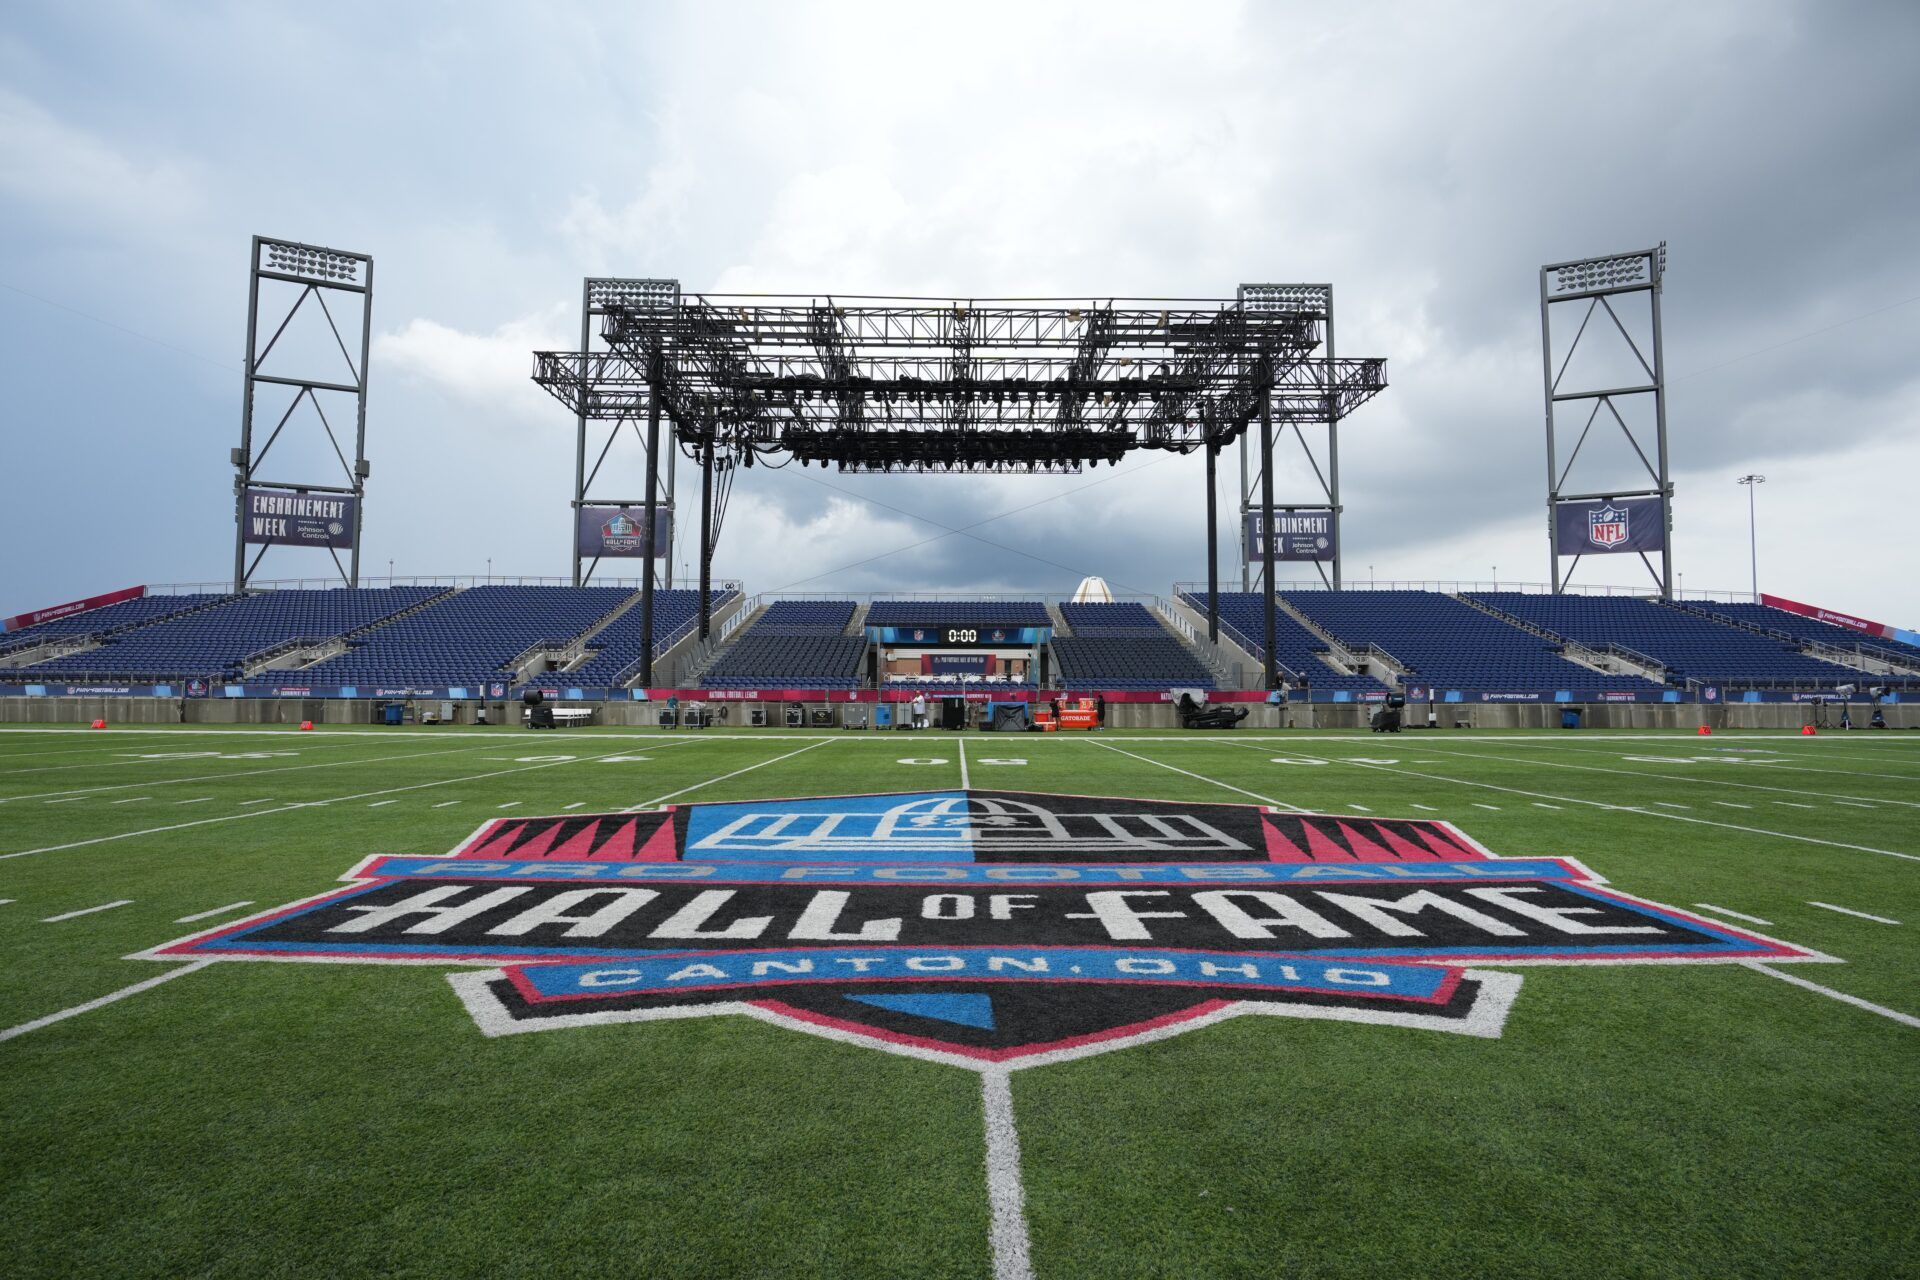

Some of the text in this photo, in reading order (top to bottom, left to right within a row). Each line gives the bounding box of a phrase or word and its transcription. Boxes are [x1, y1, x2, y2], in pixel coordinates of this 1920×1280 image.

[253, 495, 345, 519] ENSHRINEMENT
[253, 517, 287, 537] WEEK
[297, 526, 325, 535] Johnson
[1594, 523, 1625, 543] NFL
[948, 629, 977, 643] 0:00
[414, 862, 1537, 880] PRO FOOTBALL
[325, 885, 1669, 942] HALL OF FAME
[577, 955, 1391, 988] CANTON OHIO
